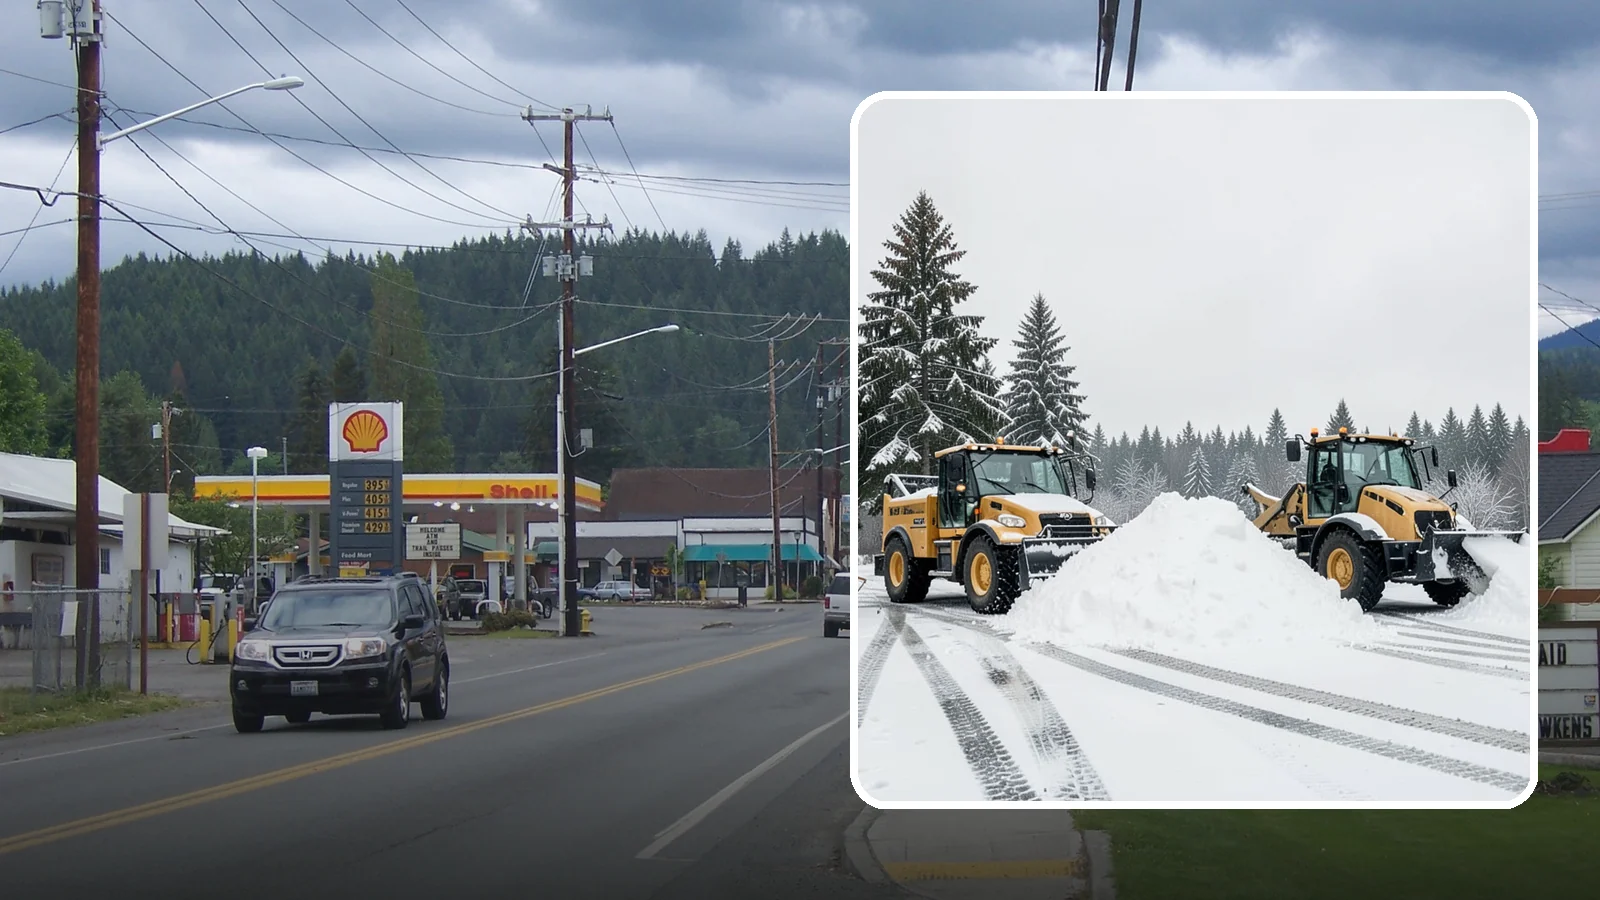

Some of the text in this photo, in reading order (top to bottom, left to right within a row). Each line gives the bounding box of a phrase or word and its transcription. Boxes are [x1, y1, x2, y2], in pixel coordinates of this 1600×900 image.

[365, 480, 383, 490] 395
[490, 484, 547, 499] Shell
[365, 494, 383, 504] 405
[365, 508, 383, 518] 415
[365, 522, 383, 532] 429
